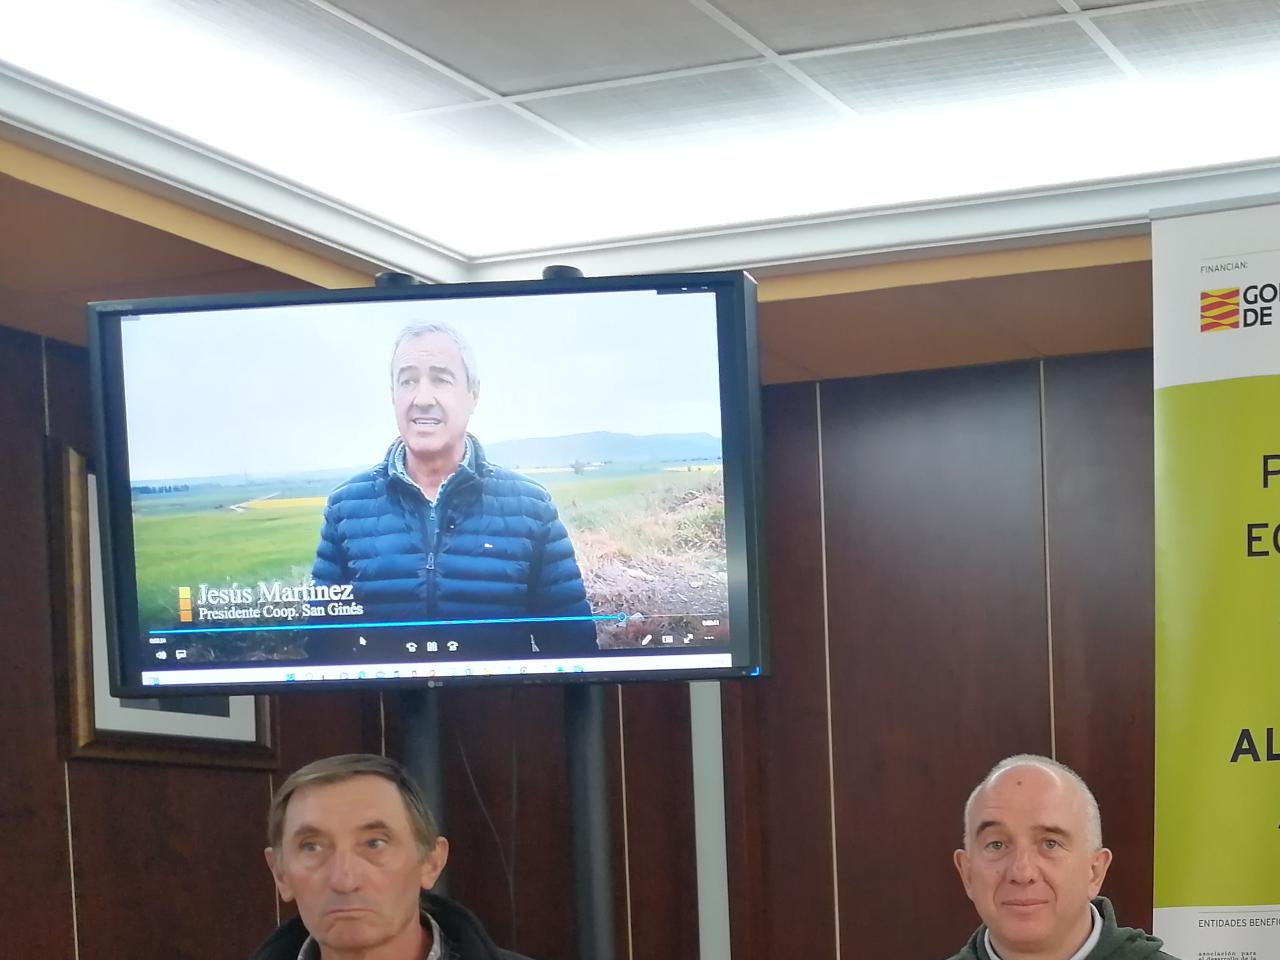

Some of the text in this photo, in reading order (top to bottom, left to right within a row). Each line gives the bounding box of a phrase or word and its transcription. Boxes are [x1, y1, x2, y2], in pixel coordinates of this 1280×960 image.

[1200, 261, 1248, 273] FINANCIAN:
[1243, 306, 1273, 328] DE
[197, 580, 354, 605] Jesús Martínez
[199, 602, 364, 620] Presidente Coop. San Ginés
[1198, 919, 1247, 928] ENTIDADES
